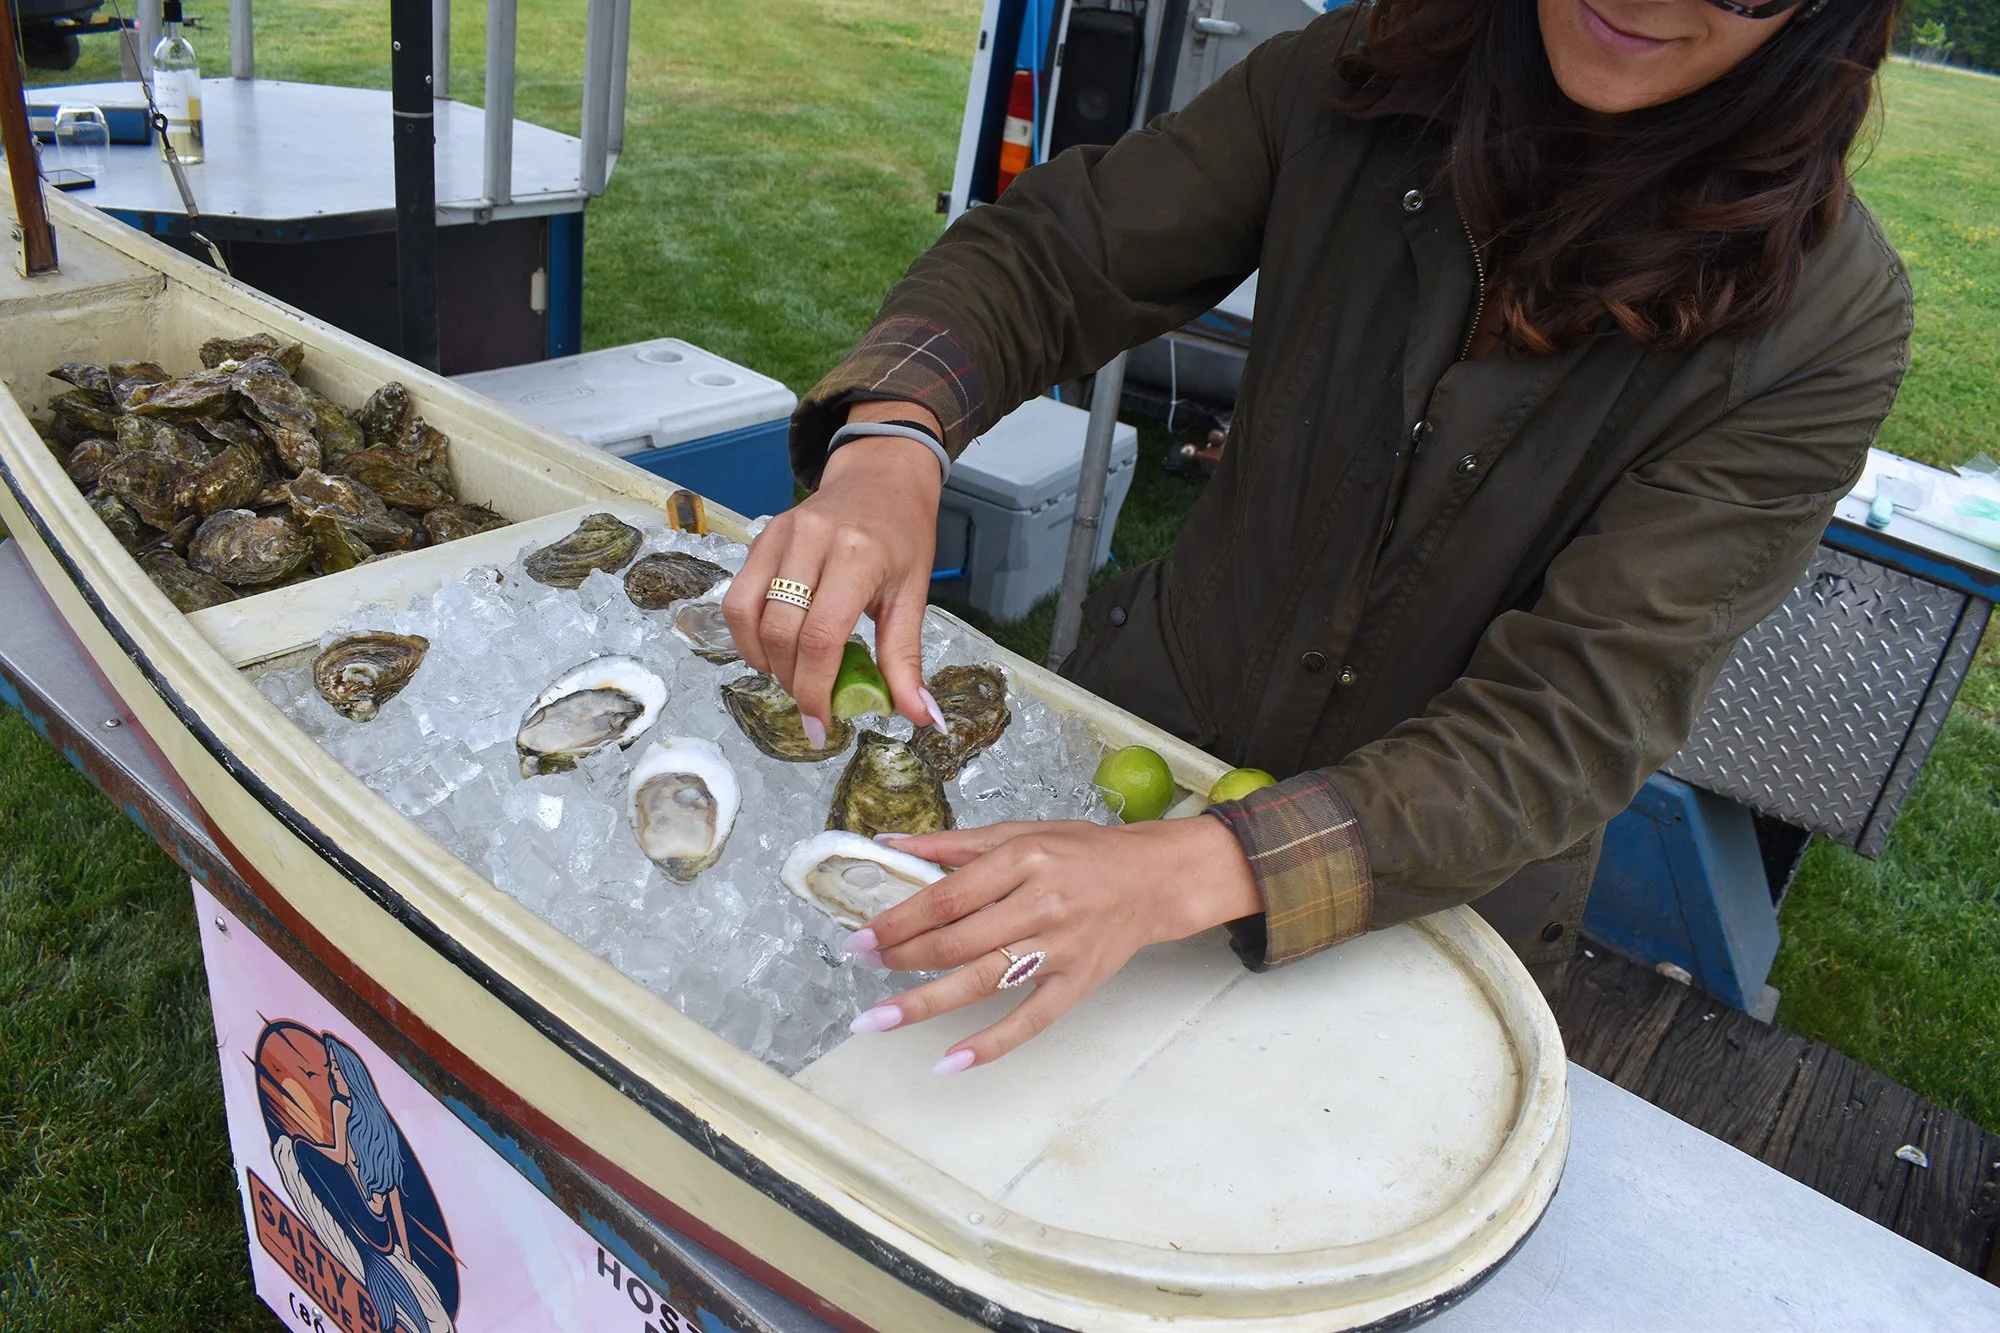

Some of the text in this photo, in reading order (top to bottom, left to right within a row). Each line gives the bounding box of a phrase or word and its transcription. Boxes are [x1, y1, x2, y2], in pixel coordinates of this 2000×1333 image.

[259, 1190, 347, 1299] SALTY
[292, 1255, 354, 1333] BLUE
[597, 1246, 702, 1333] HOS
